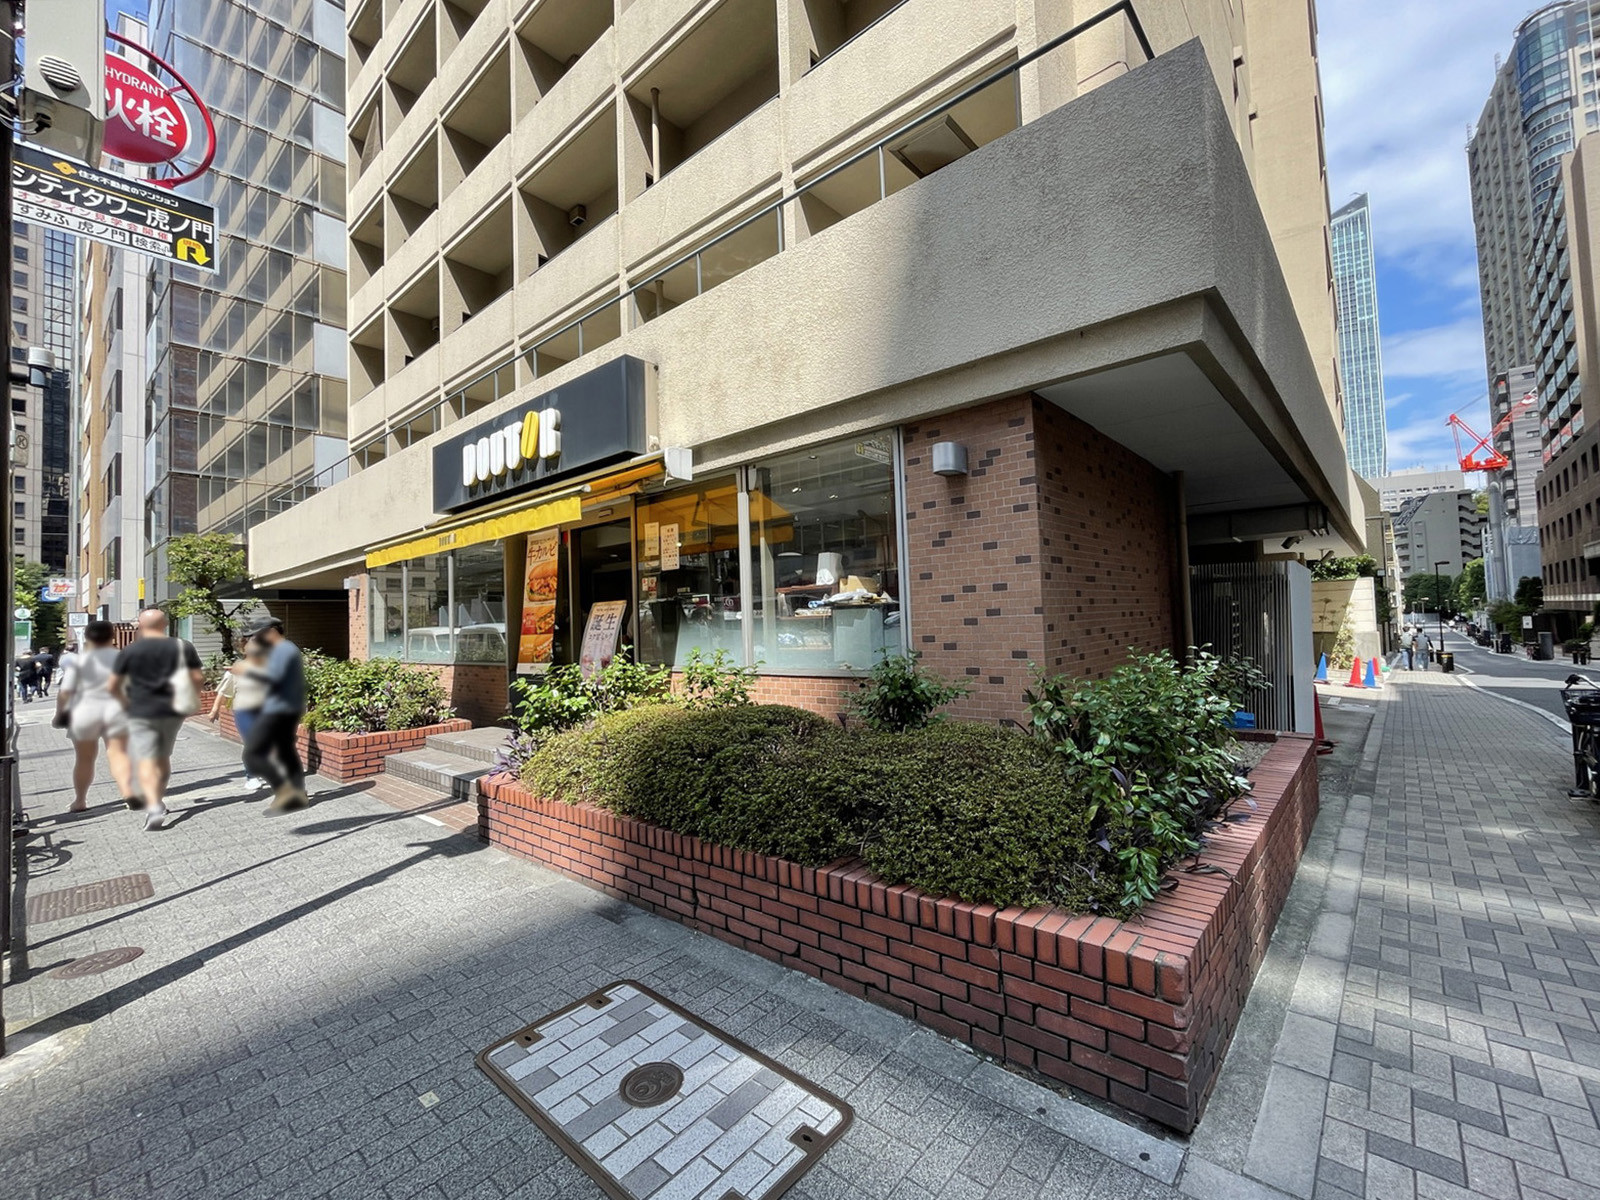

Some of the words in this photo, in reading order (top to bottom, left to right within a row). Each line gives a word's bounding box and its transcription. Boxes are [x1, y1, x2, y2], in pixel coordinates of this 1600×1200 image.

[105, 65, 165, 99] HYDRANT
[12, 165, 213, 244] シティタワー虎ノ門
[17, 202, 70, 226] すみふ
[77, 221, 126, 242] 虎ノ門
